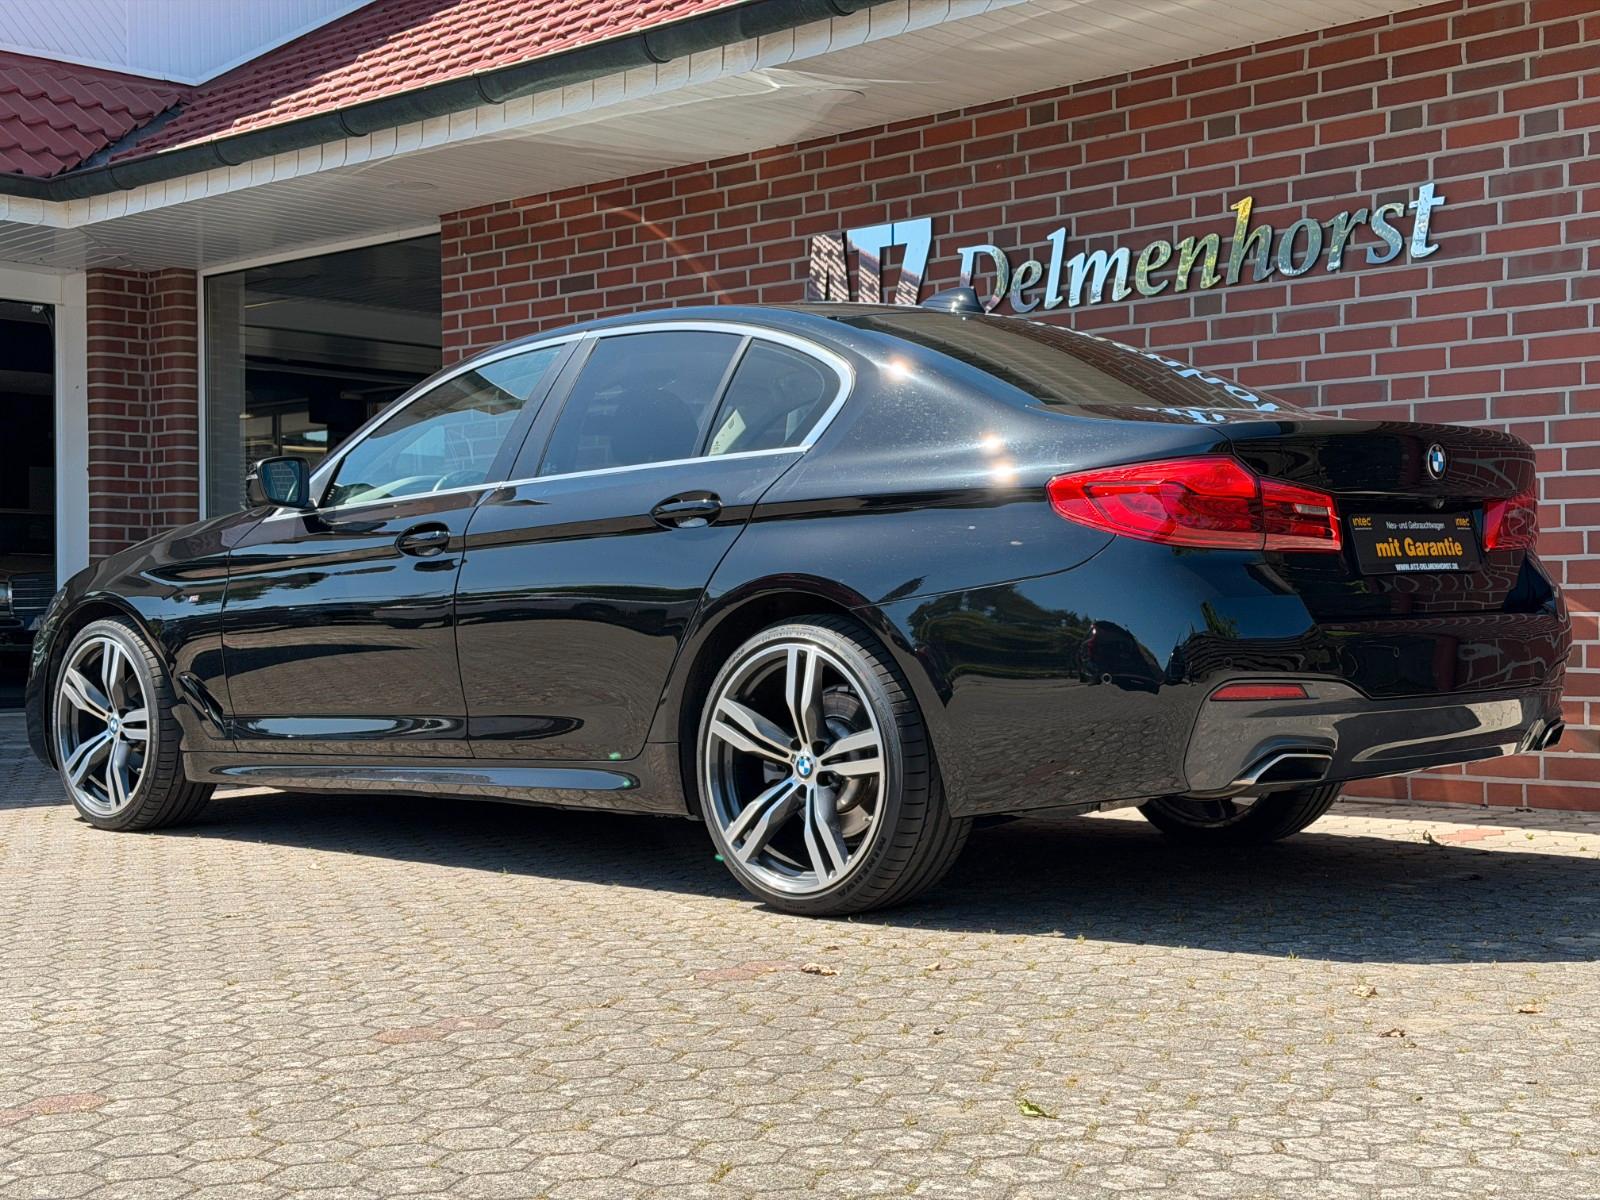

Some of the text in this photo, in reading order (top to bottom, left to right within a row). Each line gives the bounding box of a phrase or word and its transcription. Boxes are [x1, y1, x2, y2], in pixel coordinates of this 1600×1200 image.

[957, 182, 1445, 314] Delmenhorst
[1408, 520, 1445, 531] Gebrauchtwagen
[1375, 536, 1463, 557] mit Garantie
